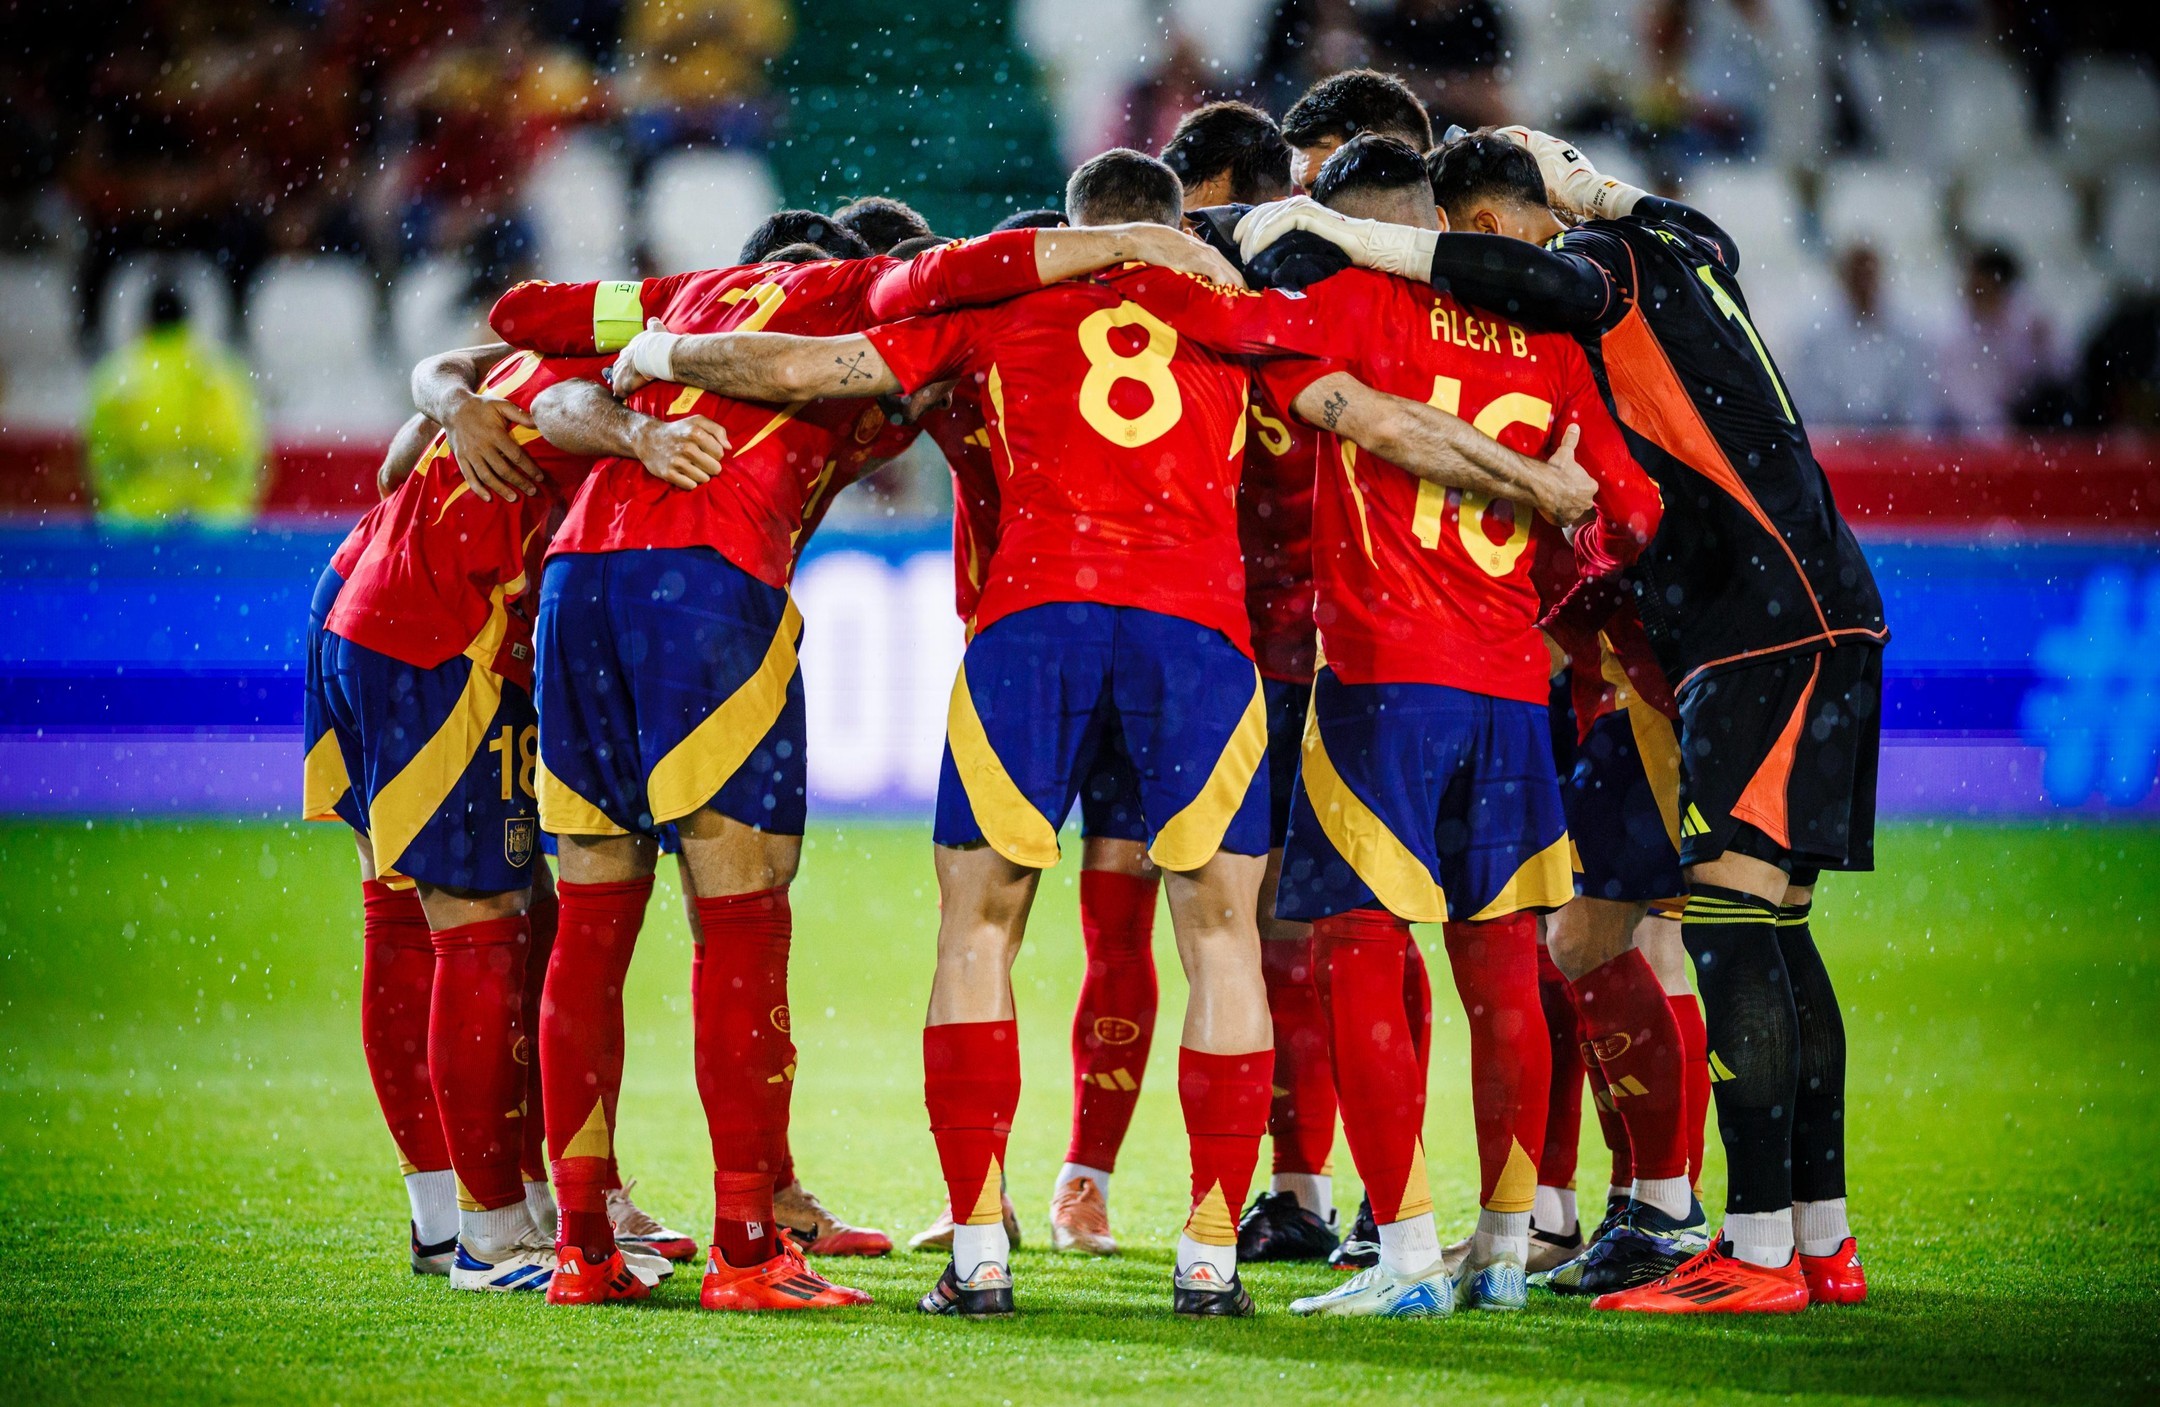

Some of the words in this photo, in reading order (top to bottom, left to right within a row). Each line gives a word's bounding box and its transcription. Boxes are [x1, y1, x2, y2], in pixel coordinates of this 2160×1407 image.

[1593, 188, 1603, 206] DAVID
[1599, 192, 1607, 207] RAYA
[1430, 298, 1501, 354] ÁLEX
[1508, 325, 1537, 362] B.
[1078, 300, 1183, 448] 8
[1411, 374, 1553, 578] 16
[489, 724, 538, 800] 18
